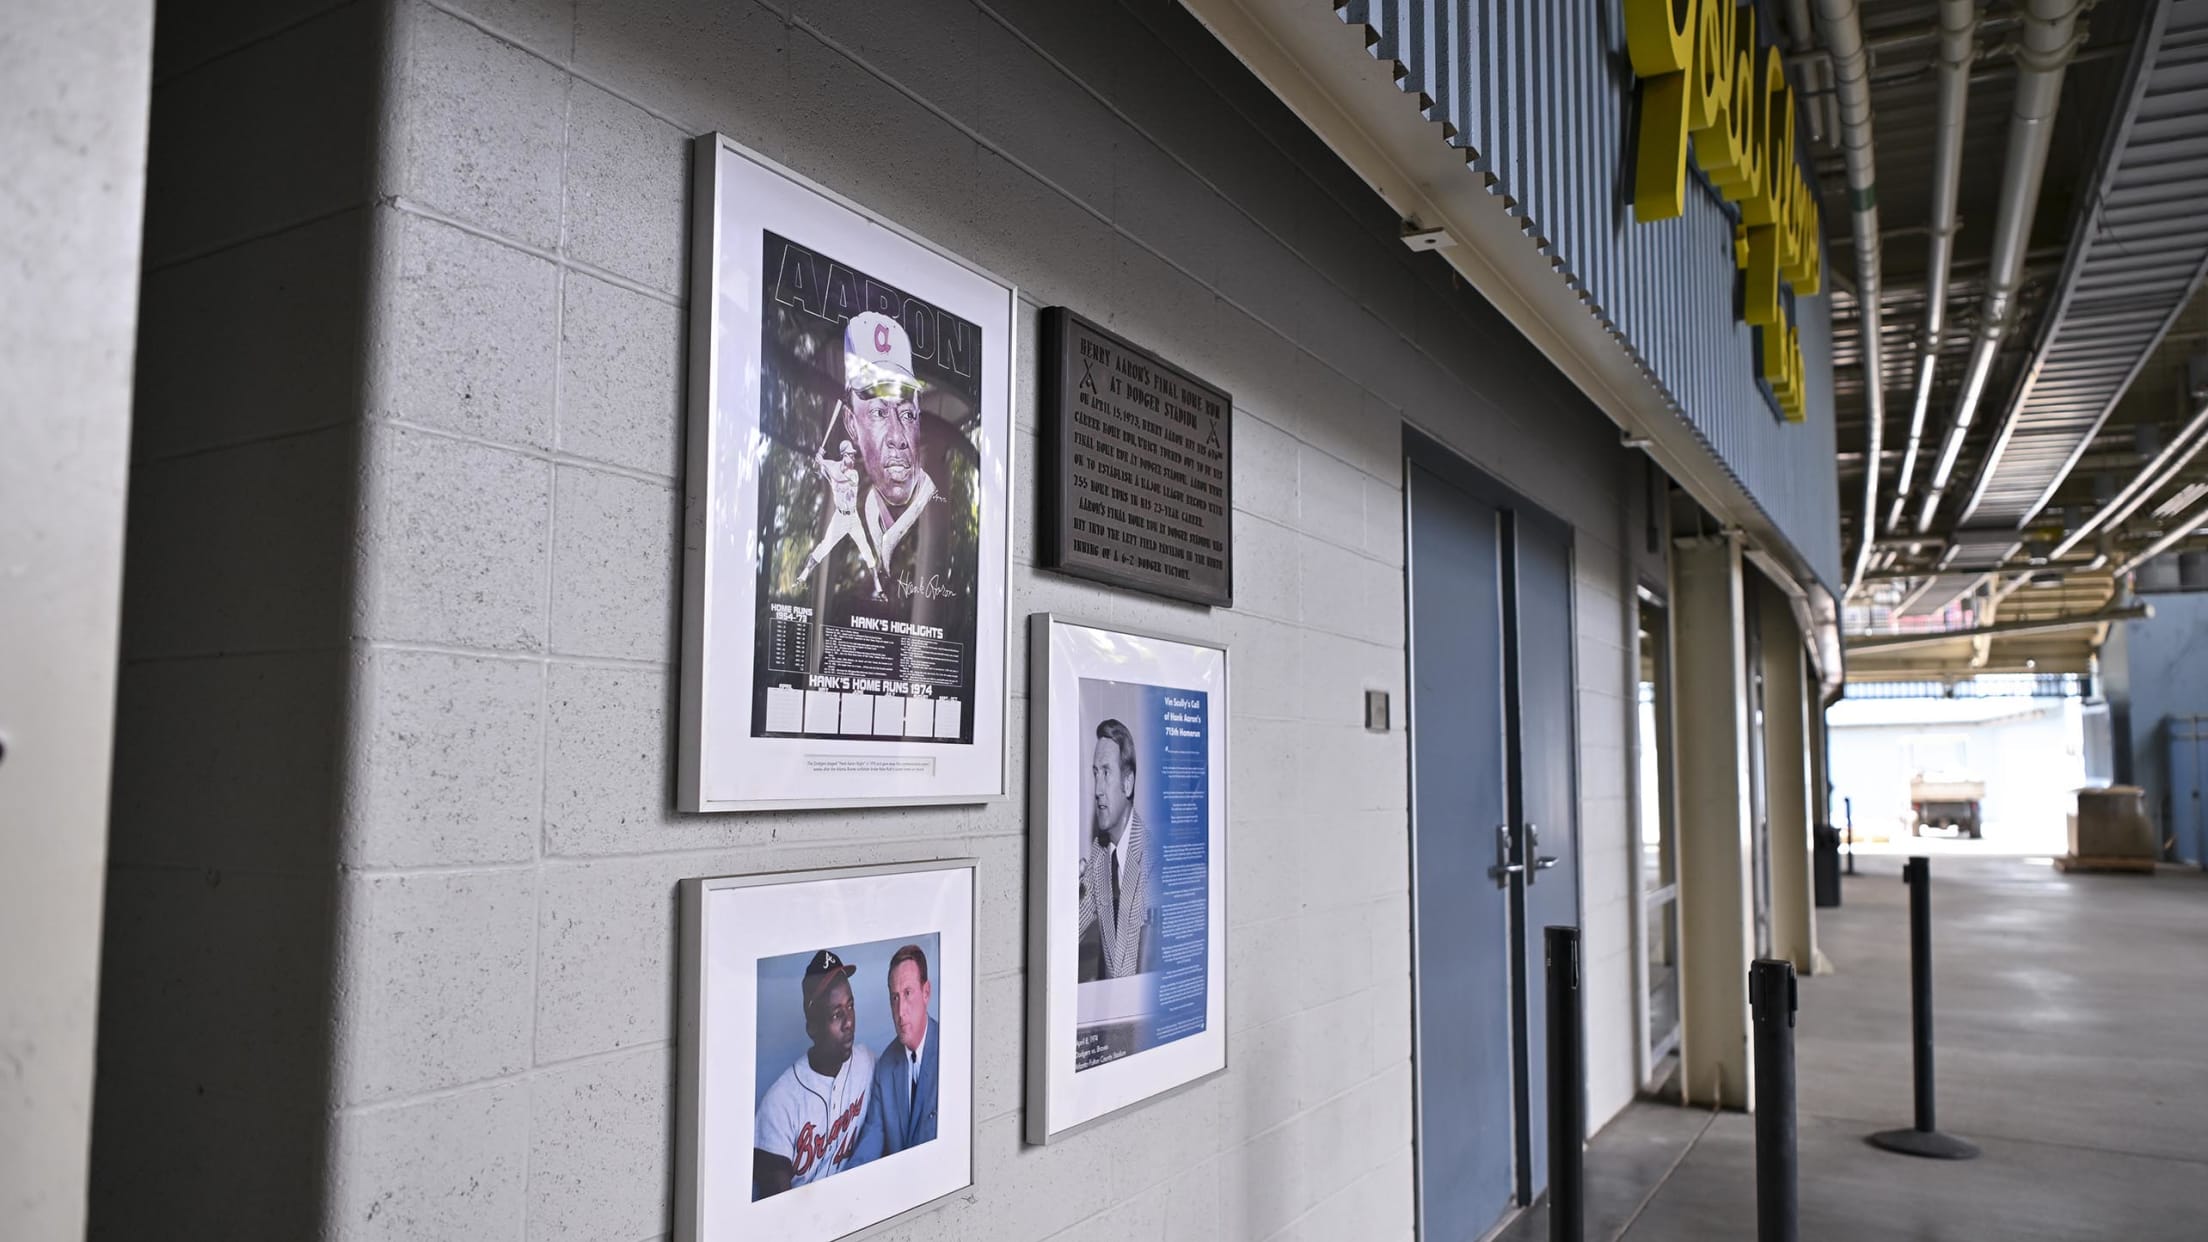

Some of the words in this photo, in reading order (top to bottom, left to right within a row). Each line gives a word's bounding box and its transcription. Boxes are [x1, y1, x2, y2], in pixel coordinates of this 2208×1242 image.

[775, 244, 972, 378] AARON
[1080, 337, 1110, 368] HENRY
[1115, 355, 1150, 386] AARON'S
[1154, 374, 1177, 399] FINAL
[1182, 388, 1201, 411] HOME
[1205, 399, 1220, 420] RUN
[1080, 391, 1089, 407] ON
[1091, 396, 1110, 415] APRIL
[1142, 418, 1161, 437] HENRY
[1164, 428, 1183, 446] AARON
[1110, 376, 1122, 396] AT
[1126, 383, 1160, 413] DODGER
[1164, 401, 1197, 430] STADIUM
[1074, 410, 1100, 432] CAREER
[1102, 421, 1120, 440] HOME
[1160, 445, 1182, 465] TURNED
[1184, 455, 1194, 469] OUT
[1197, 460, 1203, 473] TO
[1074, 431, 1093, 450] FINAL
[1096, 440, 1113, 457] HOME
[1116, 447, 1128, 463] RUN
[1130, 453, 1137, 466] AT
[1140, 456, 1161, 475] DODGER
[1191, 476, 1207, 492] AARON
[1073, 473, 1088, 490] 755
[1090, 479, 1109, 497] HOME
[1112, 486, 1128, 504] RUNS
[1131, 493, 1138, 507] IN
[1141, 496, 1152, 511] HIS
[1154, 501, 1179, 520] 23-YEAR
[1074, 453, 1084, 468] ON
[1087, 457, 1095, 472] TO
[1098, 461, 1133, 485] ESTABLISH
[1135, 475, 1139, 487] A
[1141, 477, 1161, 495] MAJOR
[1163, 485, 1183, 503] LEAGUE
[1186, 494, 1207, 511] RECORD
[1074, 517, 1085, 532] HIT
[1088, 522, 1105, 537] INTO
[1107, 527, 1120, 542] THE
[1122, 532, 1137, 546] LEFT
[1140, 537, 1157, 552] FIELD
[1159, 542, 1184, 559] PAVILION
[1079, 496, 1106, 517] AARON'S
[1107, 505, 1127, 523] FINAL
[1128, 512, 1145, 529] HOME
[1147, 518, 1158, 533] RUN
[1160, 522, 1165, 535] AT
[1168, 525, 1188, 542] DODGER
[1073, 539, 1099, 557] INNING
[1102, 546, 1110, 560] OF
[1113, 550, 1118, 562] A
[1122, 552, 1134, 566] 6-2
[1138, 556, 1161, 573] DODGER
[771, 603, 793, 613] HOME
[793, 606, 813, 616] RUNS
[851, 615, 889, 632] HANK'S
[890, 620, 944, 640] HIGHLIGHTS
[809, 675, 850, 690] HANK'S
[852, 676, 881, 692] HOME
[883, 679, 909, 694] RUNS
[910, 683, 933, 696] 1974
[1164, 711, 1169, 721] of
[1170, 711, 1183, 721] Hank
[823, 951, 836, 969] A
[793, 1089, 865, 1176] Braves
